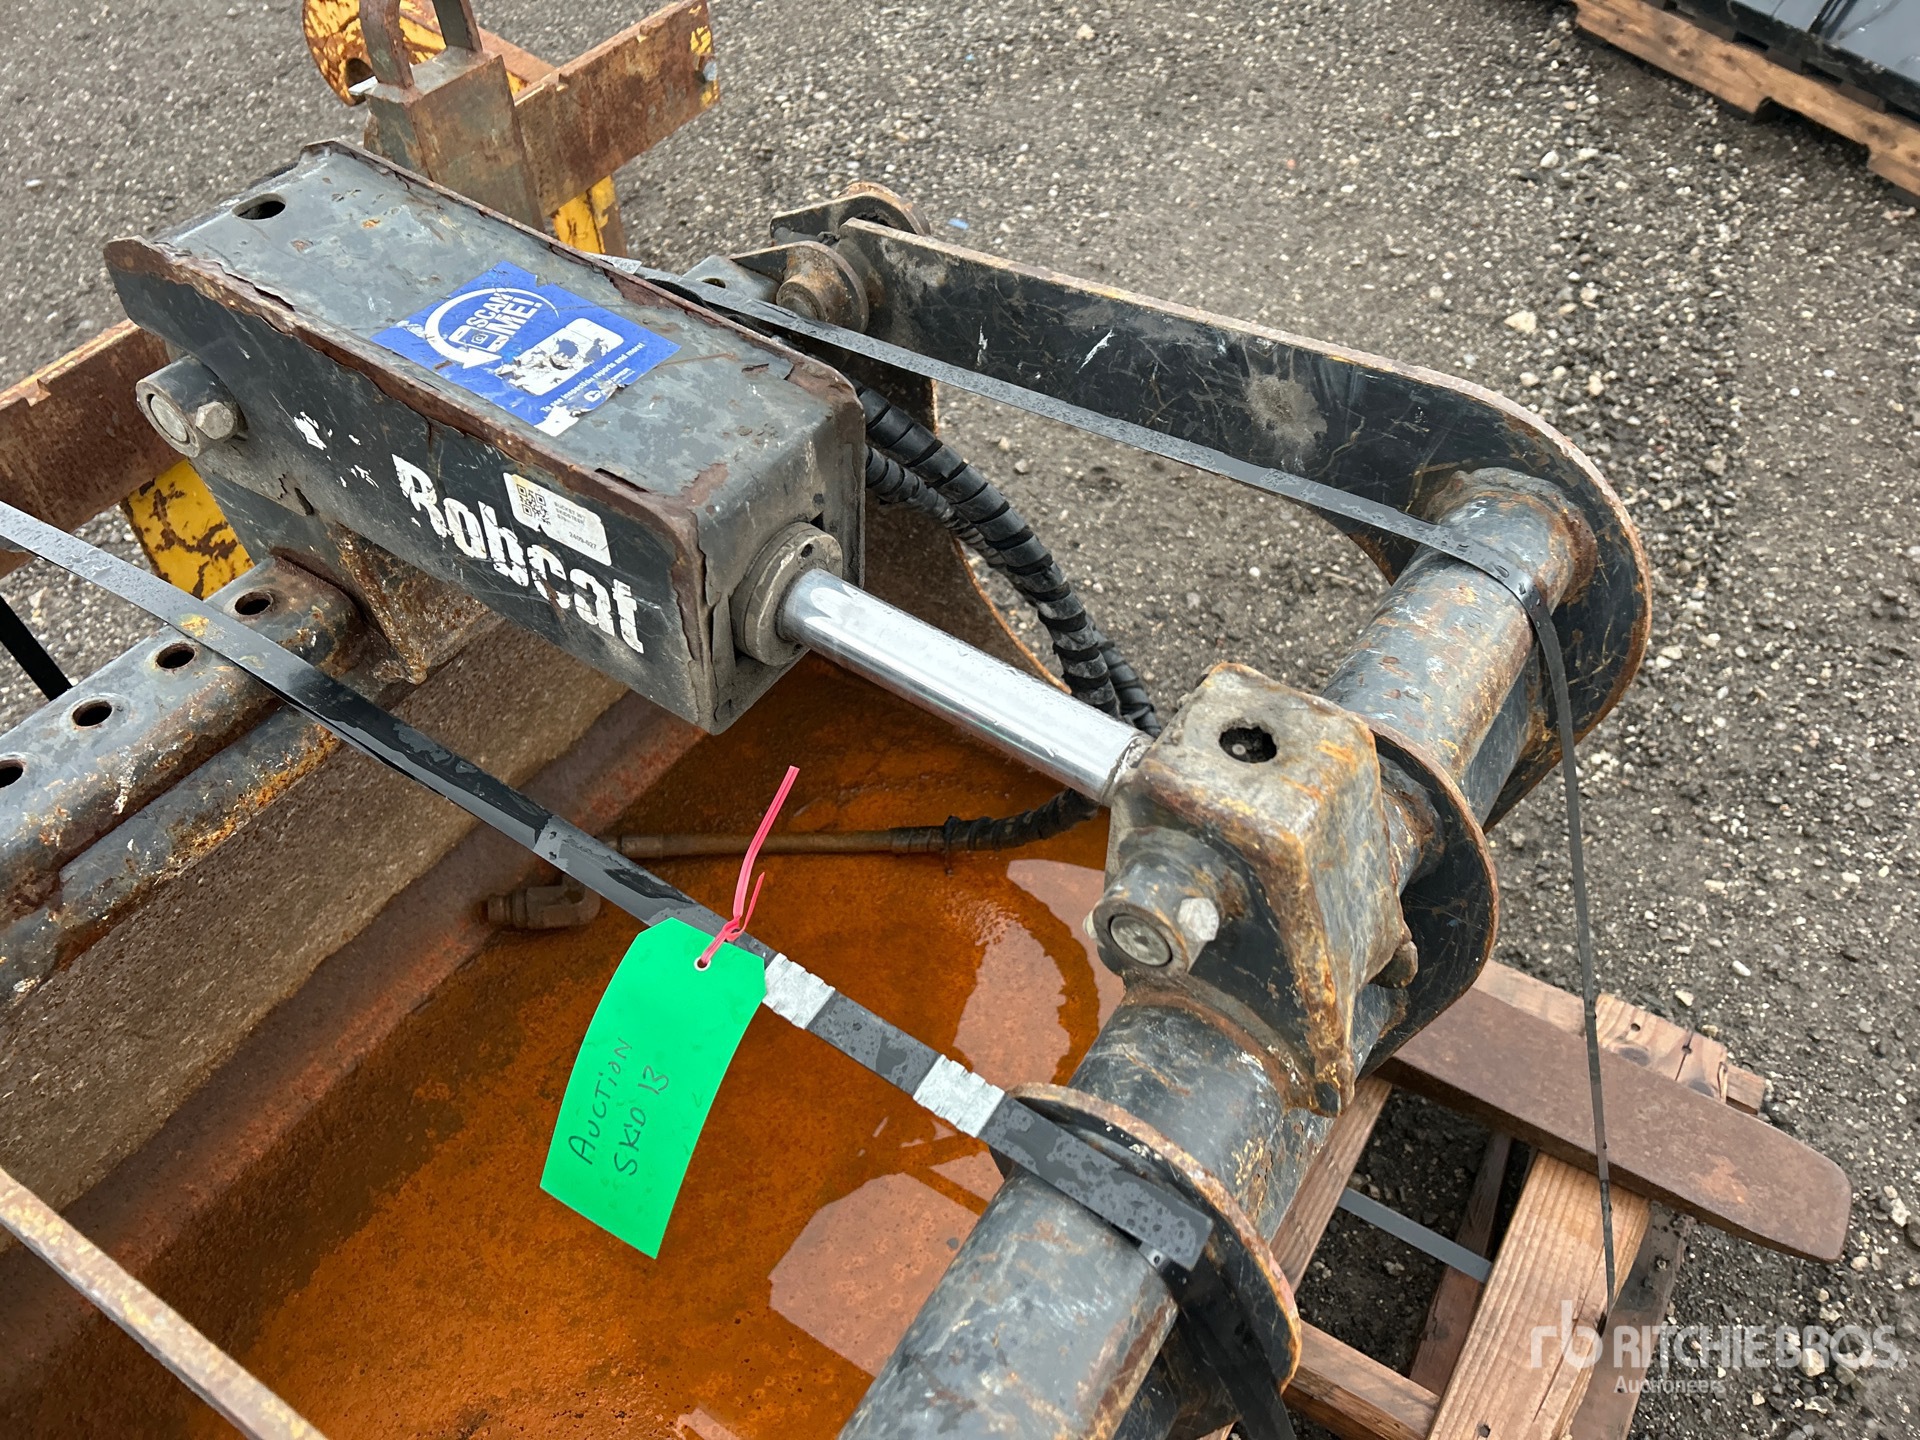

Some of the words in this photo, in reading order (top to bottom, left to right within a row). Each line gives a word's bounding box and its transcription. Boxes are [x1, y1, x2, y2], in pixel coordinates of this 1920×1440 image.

[466, 292, 514, 328] SCAN
[485, 297, 543, 336] ME!
[550, 397, 564, 407] see
[560, 377, 595, 401] inspection
[592, 362, 617, 379] reports
[614, 353, 629, 365] and
[625, 342, 646, 357] more!
[638, 1065, 670, 1096] 13
